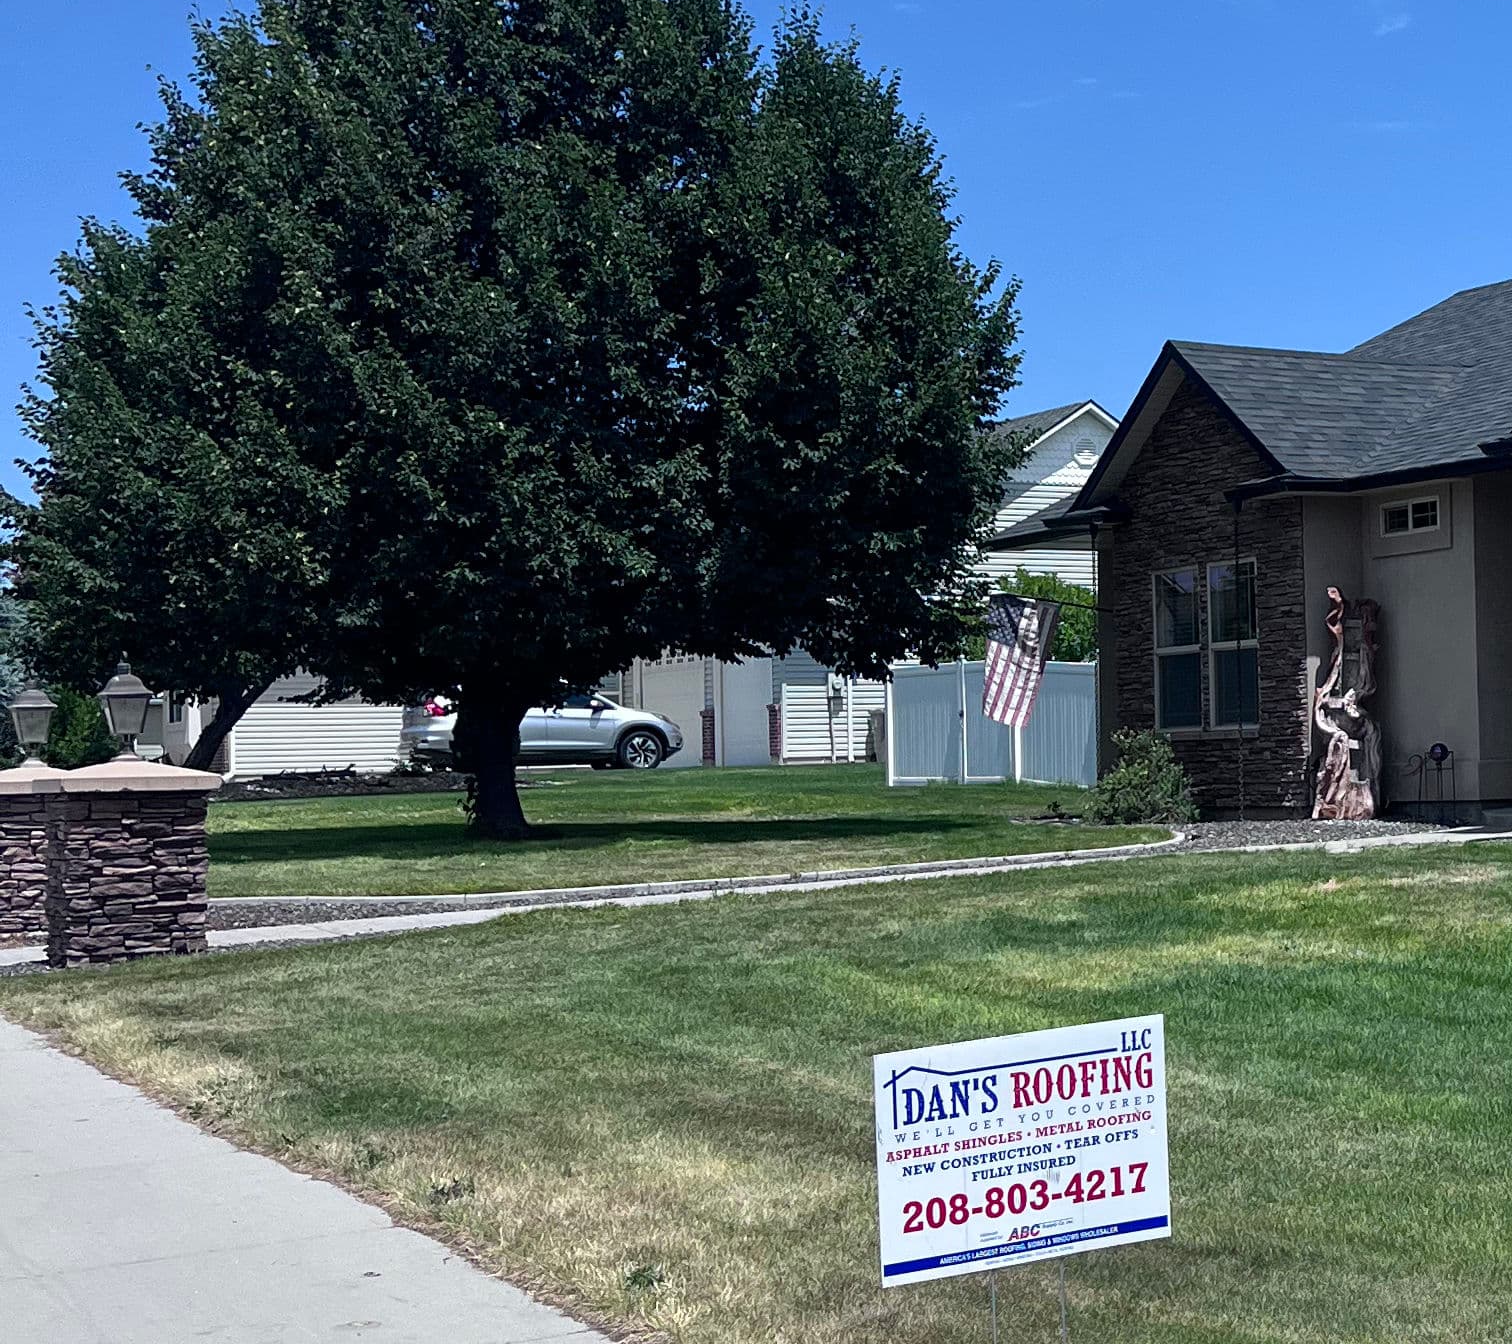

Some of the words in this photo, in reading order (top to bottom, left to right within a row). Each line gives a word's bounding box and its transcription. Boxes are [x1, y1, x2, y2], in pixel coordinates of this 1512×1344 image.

[1121, 1028, 1152, 1052] LLC
[902, 1075, 998, 1126] DAN'S
[1010, 1052, 1153, 1109] ROOFING
[886, 1143, 950, 1163] ASPHALT
[954, 1131, 1023, 1151] SHINGLES
[1036, 1121, 1083, 1138] METAL
[1087, 1111, 1152, 1130] ROOFING
[895, 1126, 955, 1143] WE'LL
[969, 1118, 1004, 1131] GET
[1018, 1110, 1053, 1123] YOU
[1068, 1094, 1155, 1116] COVERED
[902, 1162, 936, 1177] NEW
[940, 1143, 1052, 1170] CONSTRUCTION
[1065, 1135, 1101, 1150] TEAR
[1105, 1129, 1139, 1143] OFFS
[972, 1165, 1014, 1181] FULLY
[1017, 1155, 1076, 1174] INSURED
[903, 1162, 1149, 1234] 208-803-4217
[1007, 1223, 1041, 1242] ABC
